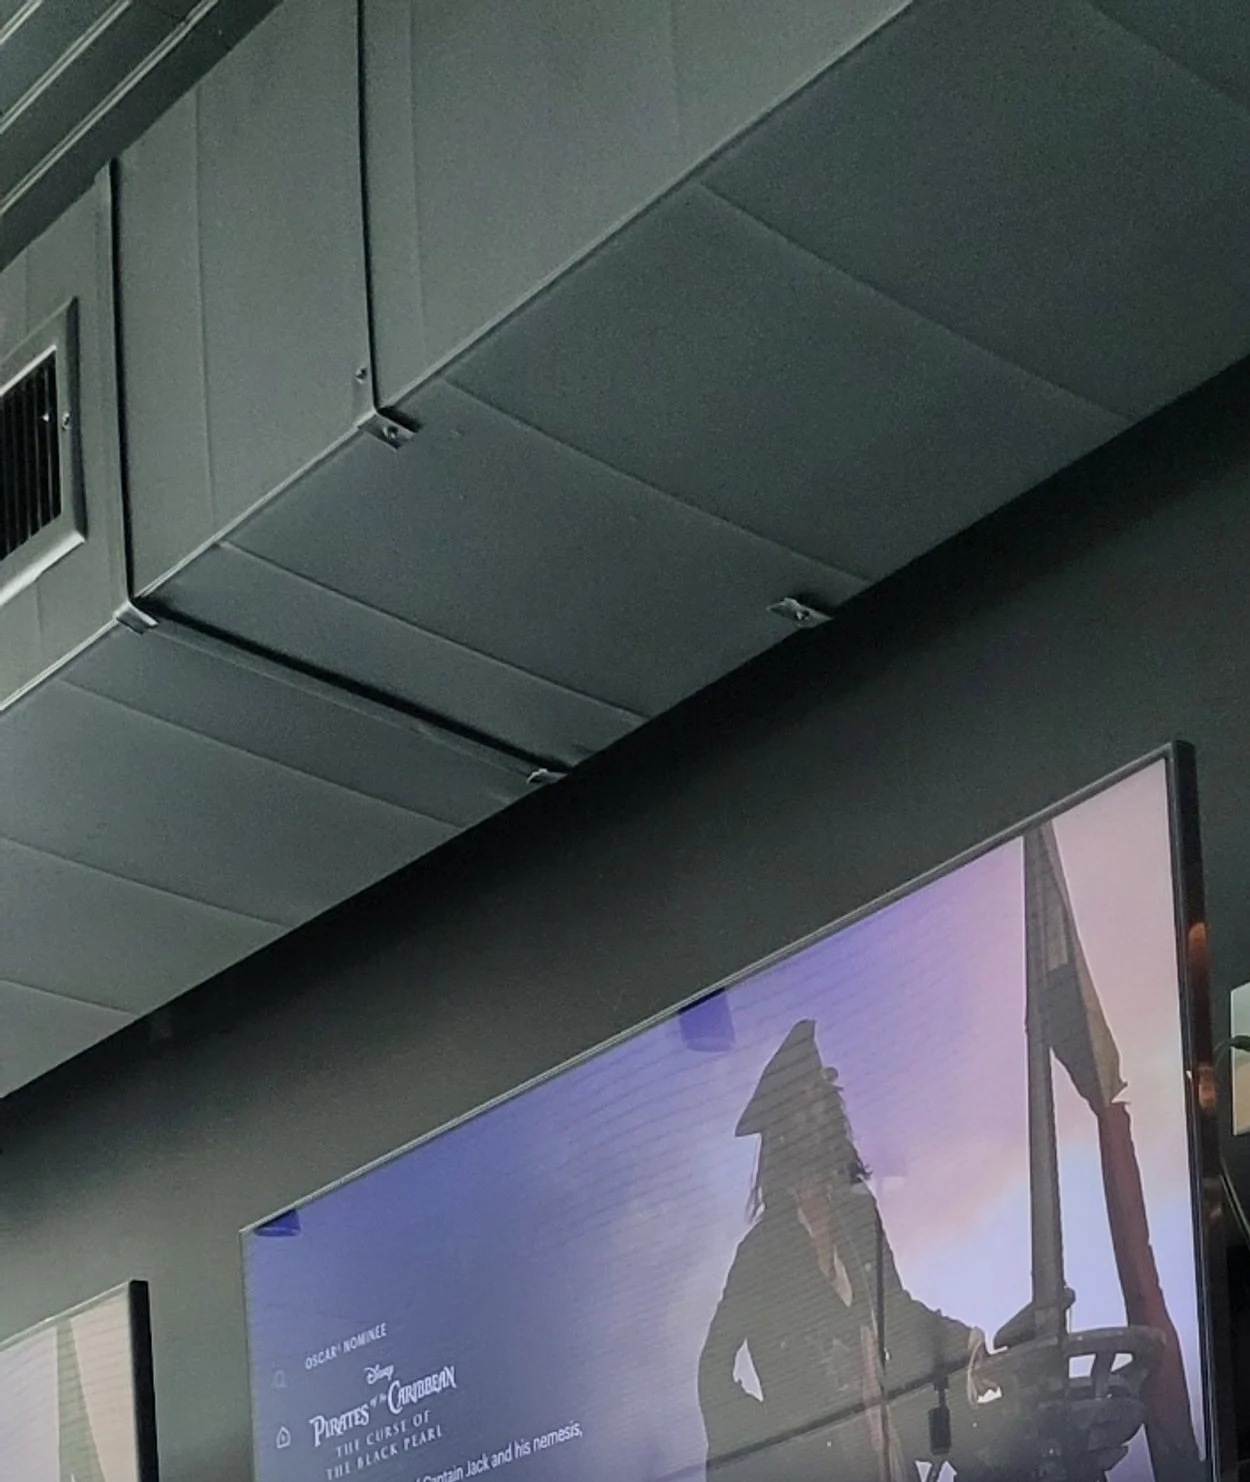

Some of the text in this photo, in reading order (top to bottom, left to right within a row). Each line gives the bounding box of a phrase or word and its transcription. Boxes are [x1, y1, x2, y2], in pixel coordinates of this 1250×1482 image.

[343, 1323, 387, 1353] NOMINEE
[364, 1364, 394, 1384] Disney
[388, 1366, 456, 1414] CARIBBEAN
[326, 1425, 442, 1481] THE BLACK PEARL
[336, 1439, 359, 1458] THE
[412, 1410, 430, 1427] OF
[465, 1454, 490, 1477] Jack
[491, 1445, 512, 1468] and
[514, 1437, 531, 1462] his
[533, 1420, 583, 1452] nemesis,
